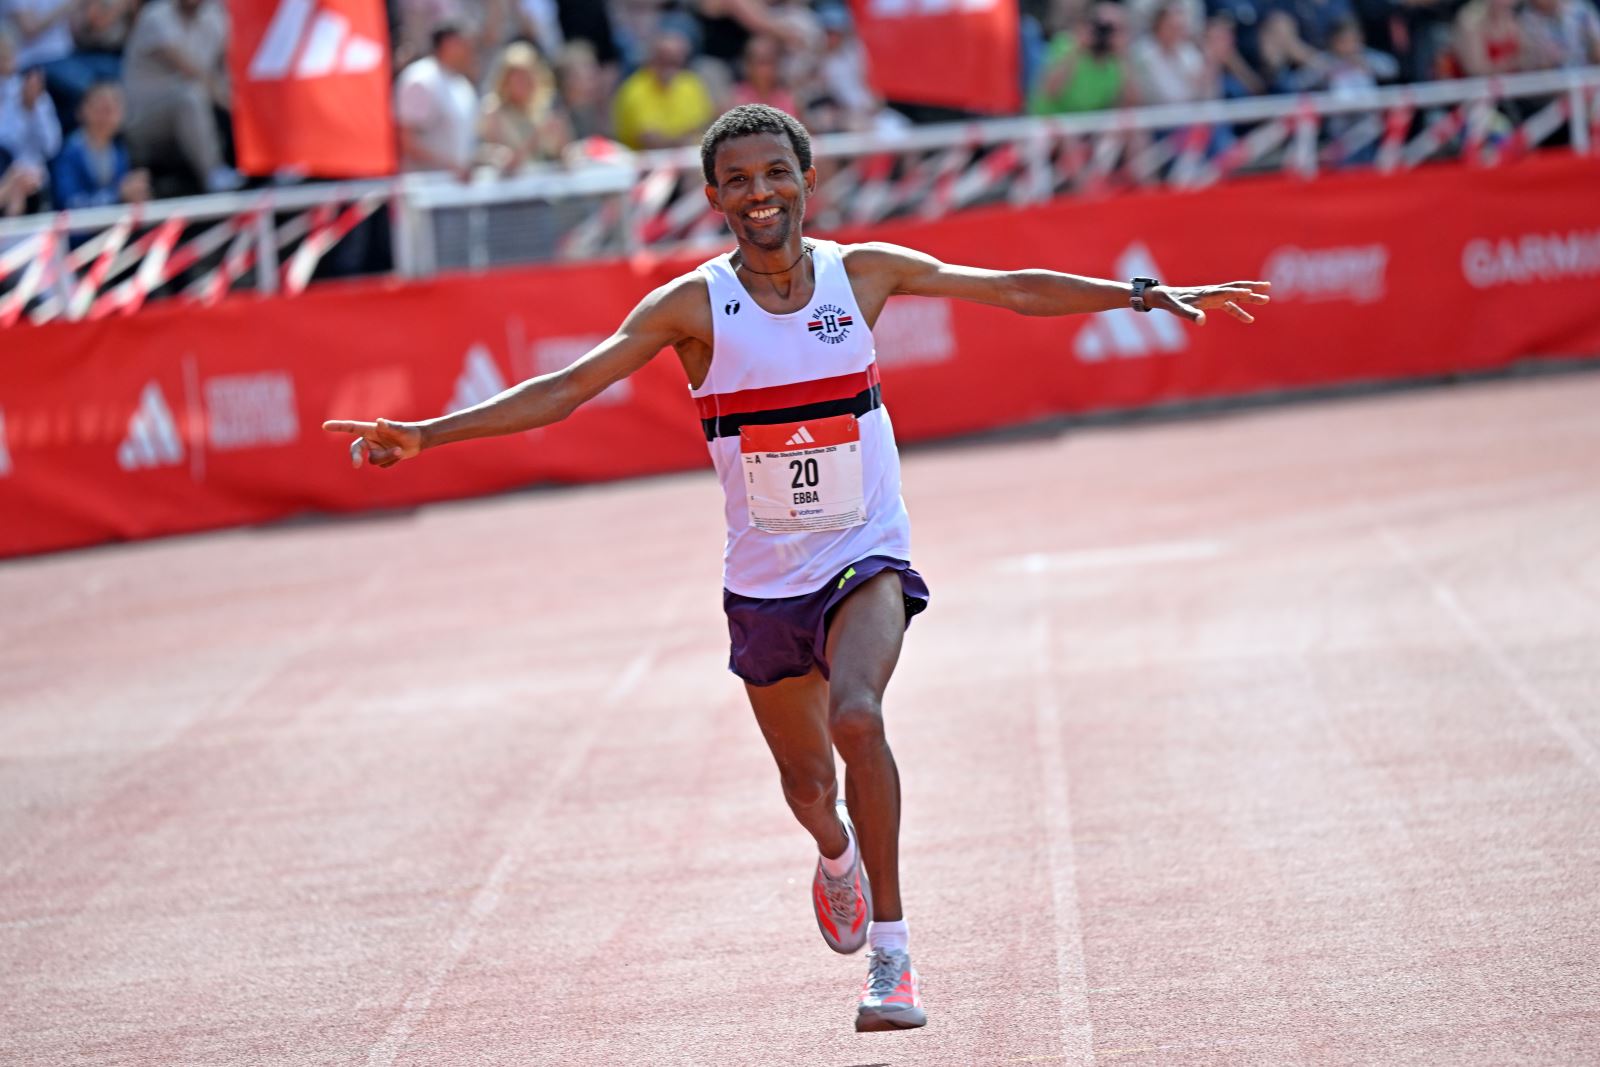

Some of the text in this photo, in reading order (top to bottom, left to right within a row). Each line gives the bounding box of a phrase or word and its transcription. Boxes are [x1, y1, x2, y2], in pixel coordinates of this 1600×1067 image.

[823, 315, 838, 333] H
[755, 455, 761, 464] A
[789, 458, 819, 488] 20
[793, 491, 819, 504] EBBA
